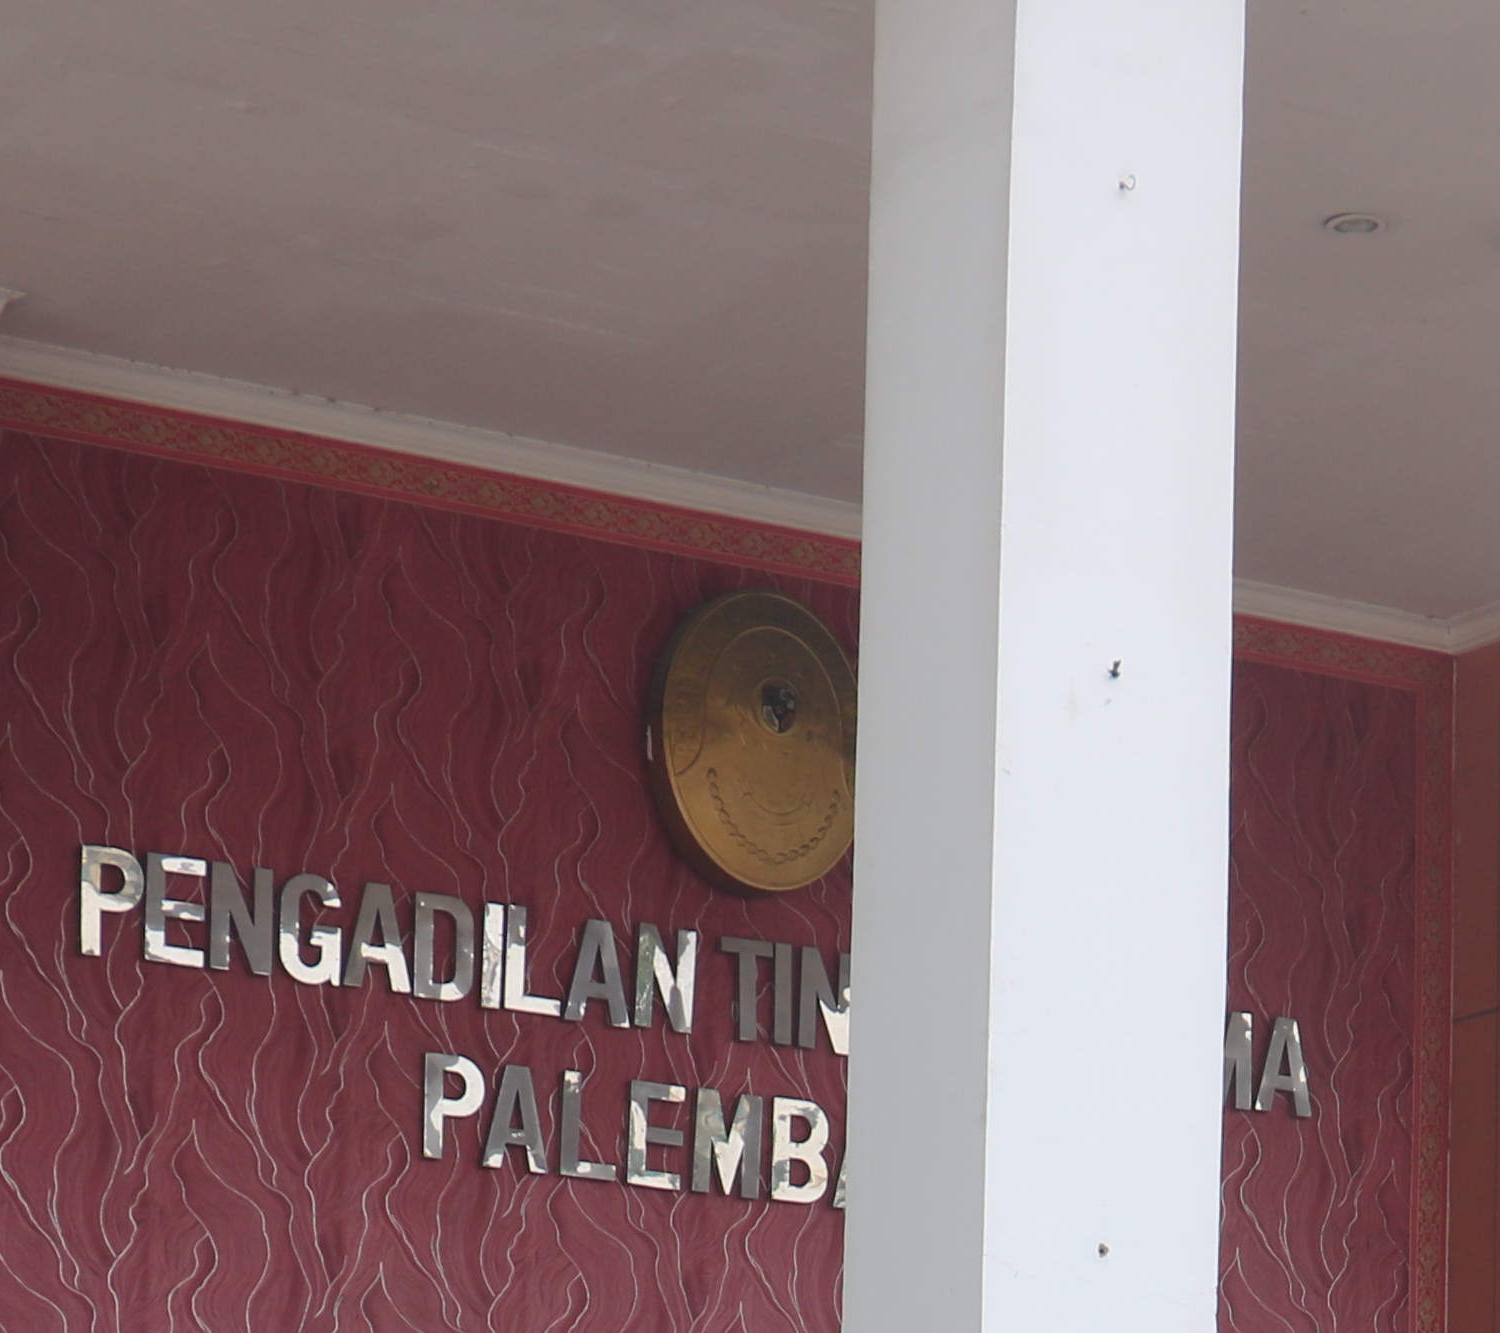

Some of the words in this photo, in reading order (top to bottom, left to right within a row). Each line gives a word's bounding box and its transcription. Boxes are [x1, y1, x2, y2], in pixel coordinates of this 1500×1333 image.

[79, 844, 697, 1034] PENGADILAN
[721, 936, 850, 1055] TIN
[1223, 1011, 1312, 1117] MA
[422, 1053, 846, 1208] PALEMB
